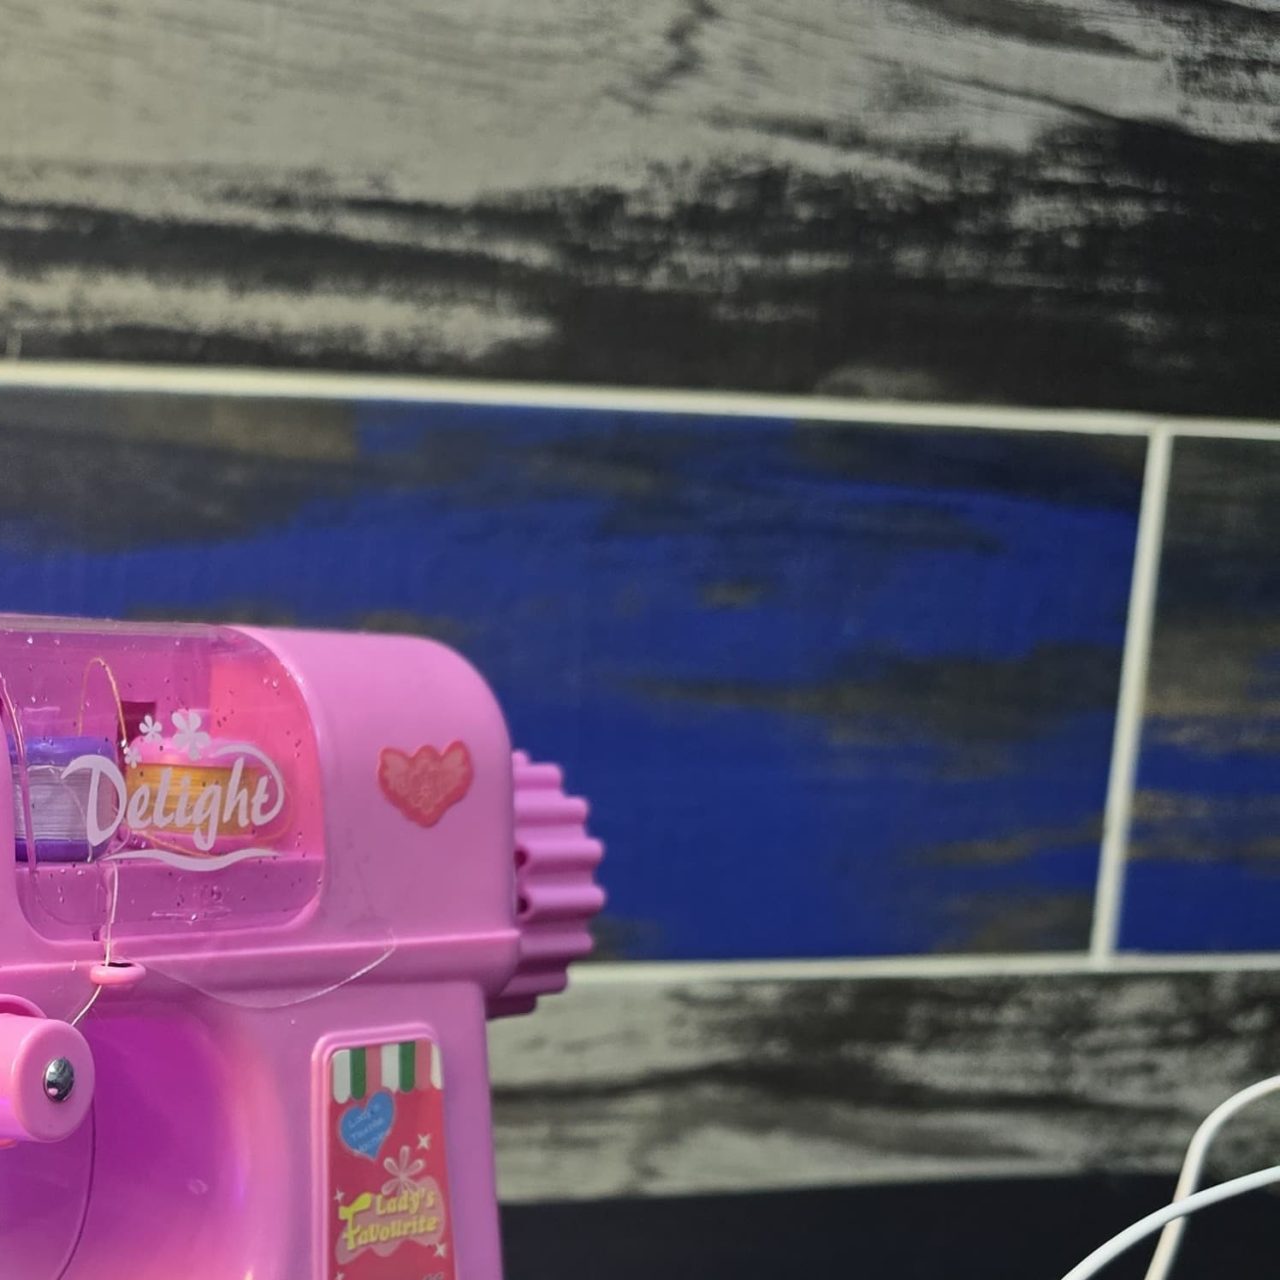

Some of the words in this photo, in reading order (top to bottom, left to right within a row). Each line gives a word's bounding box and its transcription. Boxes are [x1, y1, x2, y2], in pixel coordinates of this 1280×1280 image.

[60, 744, 285, 850] Delight
[338, 1192, 440, 1250] Favourite
[376, 1190, 435, 1215] Lady's
